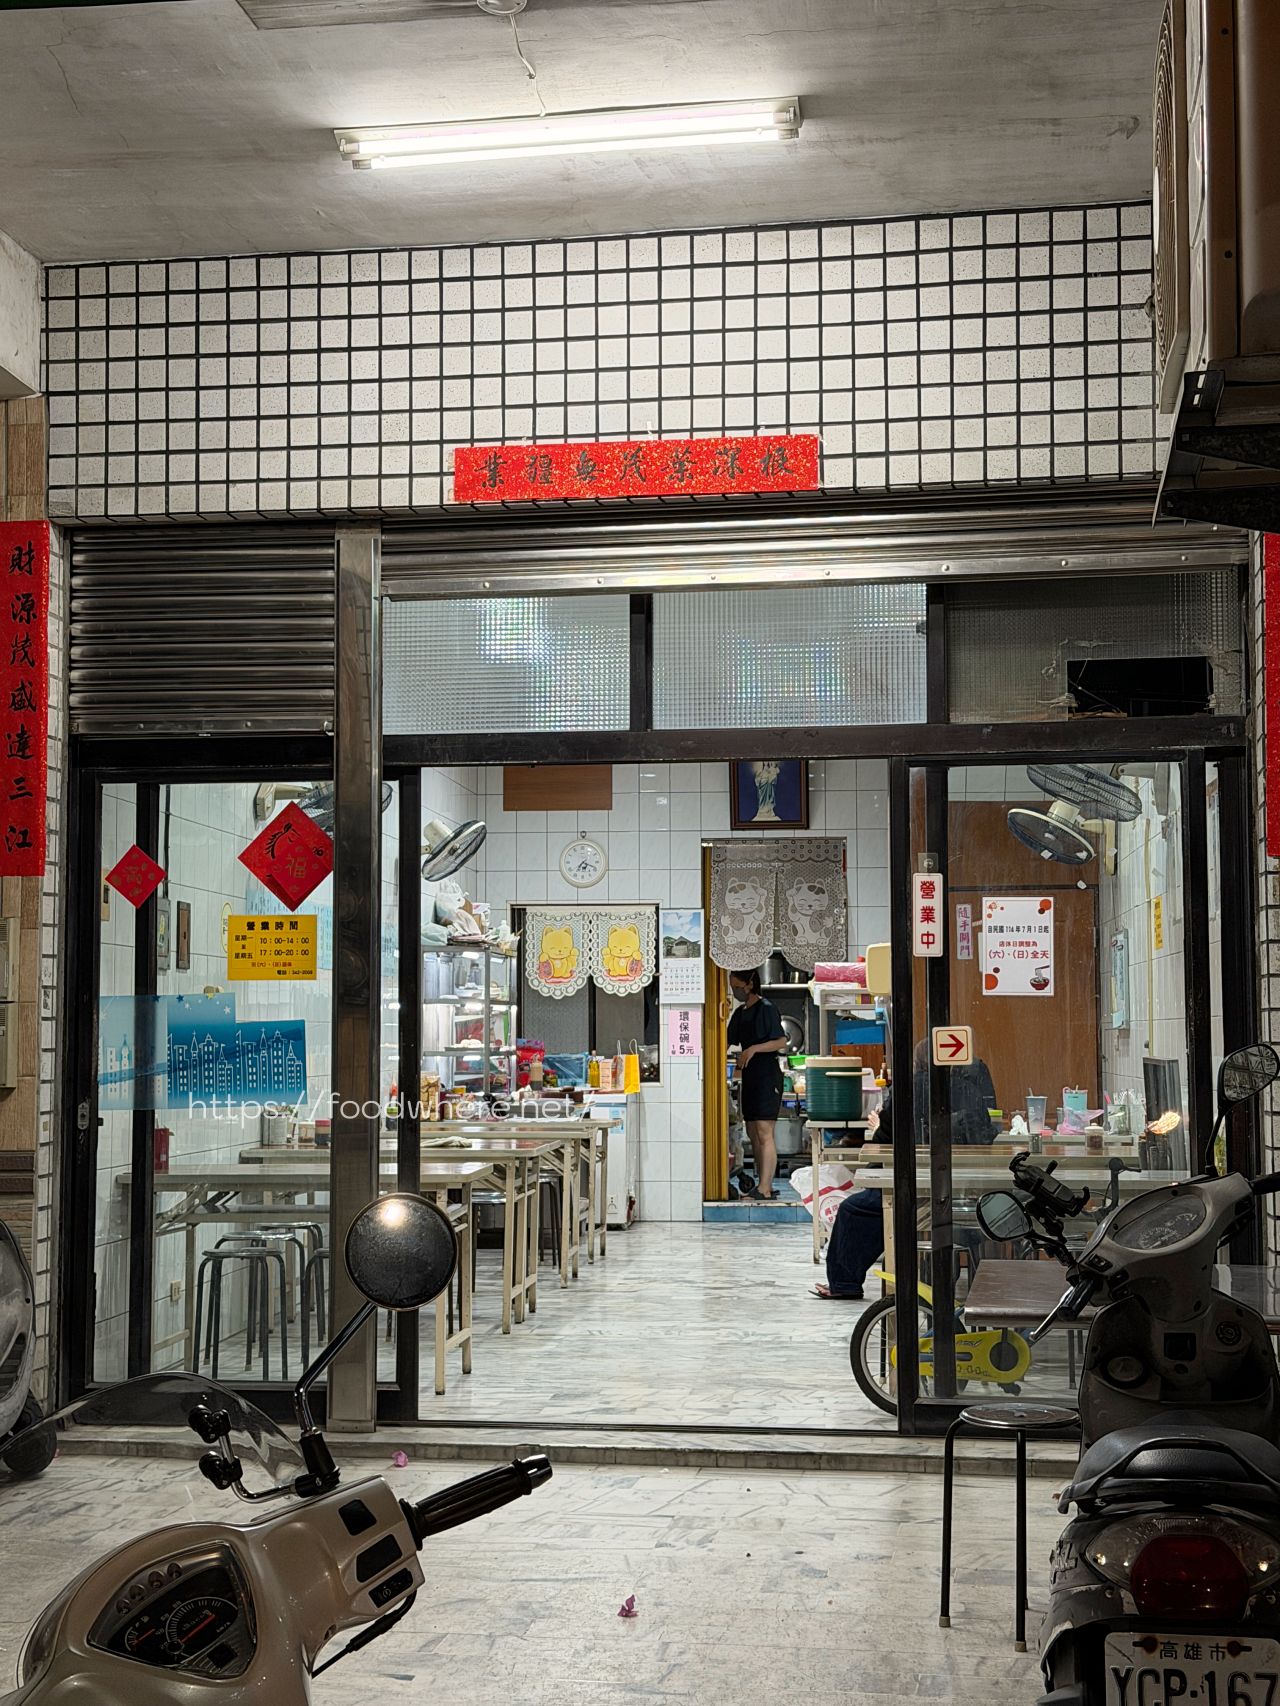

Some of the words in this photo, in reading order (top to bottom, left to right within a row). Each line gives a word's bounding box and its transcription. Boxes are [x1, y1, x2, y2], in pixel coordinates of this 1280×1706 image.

[5, 540, 38, 853] 財源茂盛達三江
[285, 853, 307, 879] 福
[246, 920, 299, 931] 營業時間
[919, 880, 936, 950] 營業中
[679, 1010, 690, 1044] 環保碗
[679, 1045, 695, 1055] 5元
[1159, 1640, 1228, 1661] 高雄市
